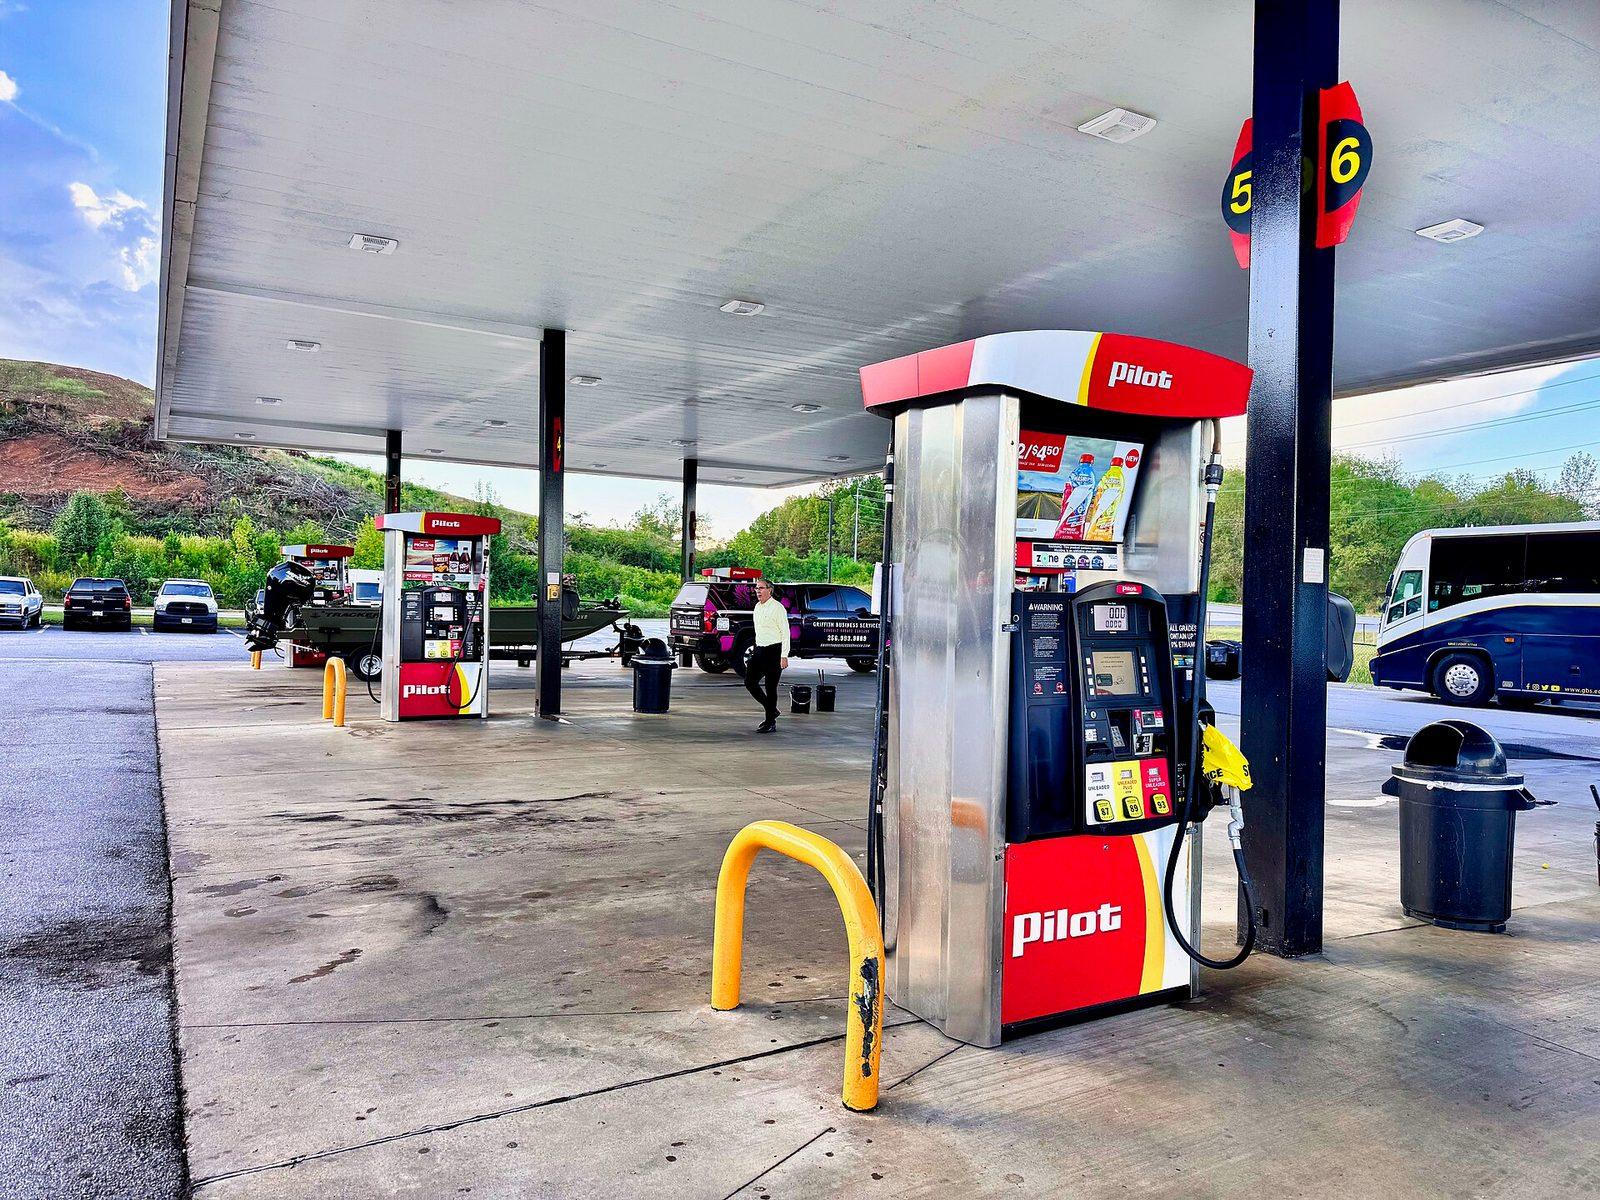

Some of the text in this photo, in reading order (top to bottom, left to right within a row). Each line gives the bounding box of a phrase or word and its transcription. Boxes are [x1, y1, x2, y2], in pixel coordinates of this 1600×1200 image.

[1330, 136, 1361, 184] 6
[1229, 170, 1252, 214] 5
[1107, 361, 1173, 389] Pilot
[1125, 455, 1140, 463] NEW
[431, 519, 460, 528] Pilot
[1033, 603, 1064, 612] WARNING
[1169, 624, 1179, 632] ALL
[403, 684, 451, 698] Pilot
[1129, 804, 1139, 813] 89
[1157, 800, 1166, 809] 93
[1100, 807, 1110, 816] 87
[1012, 902, 1122, 958] Pilot
